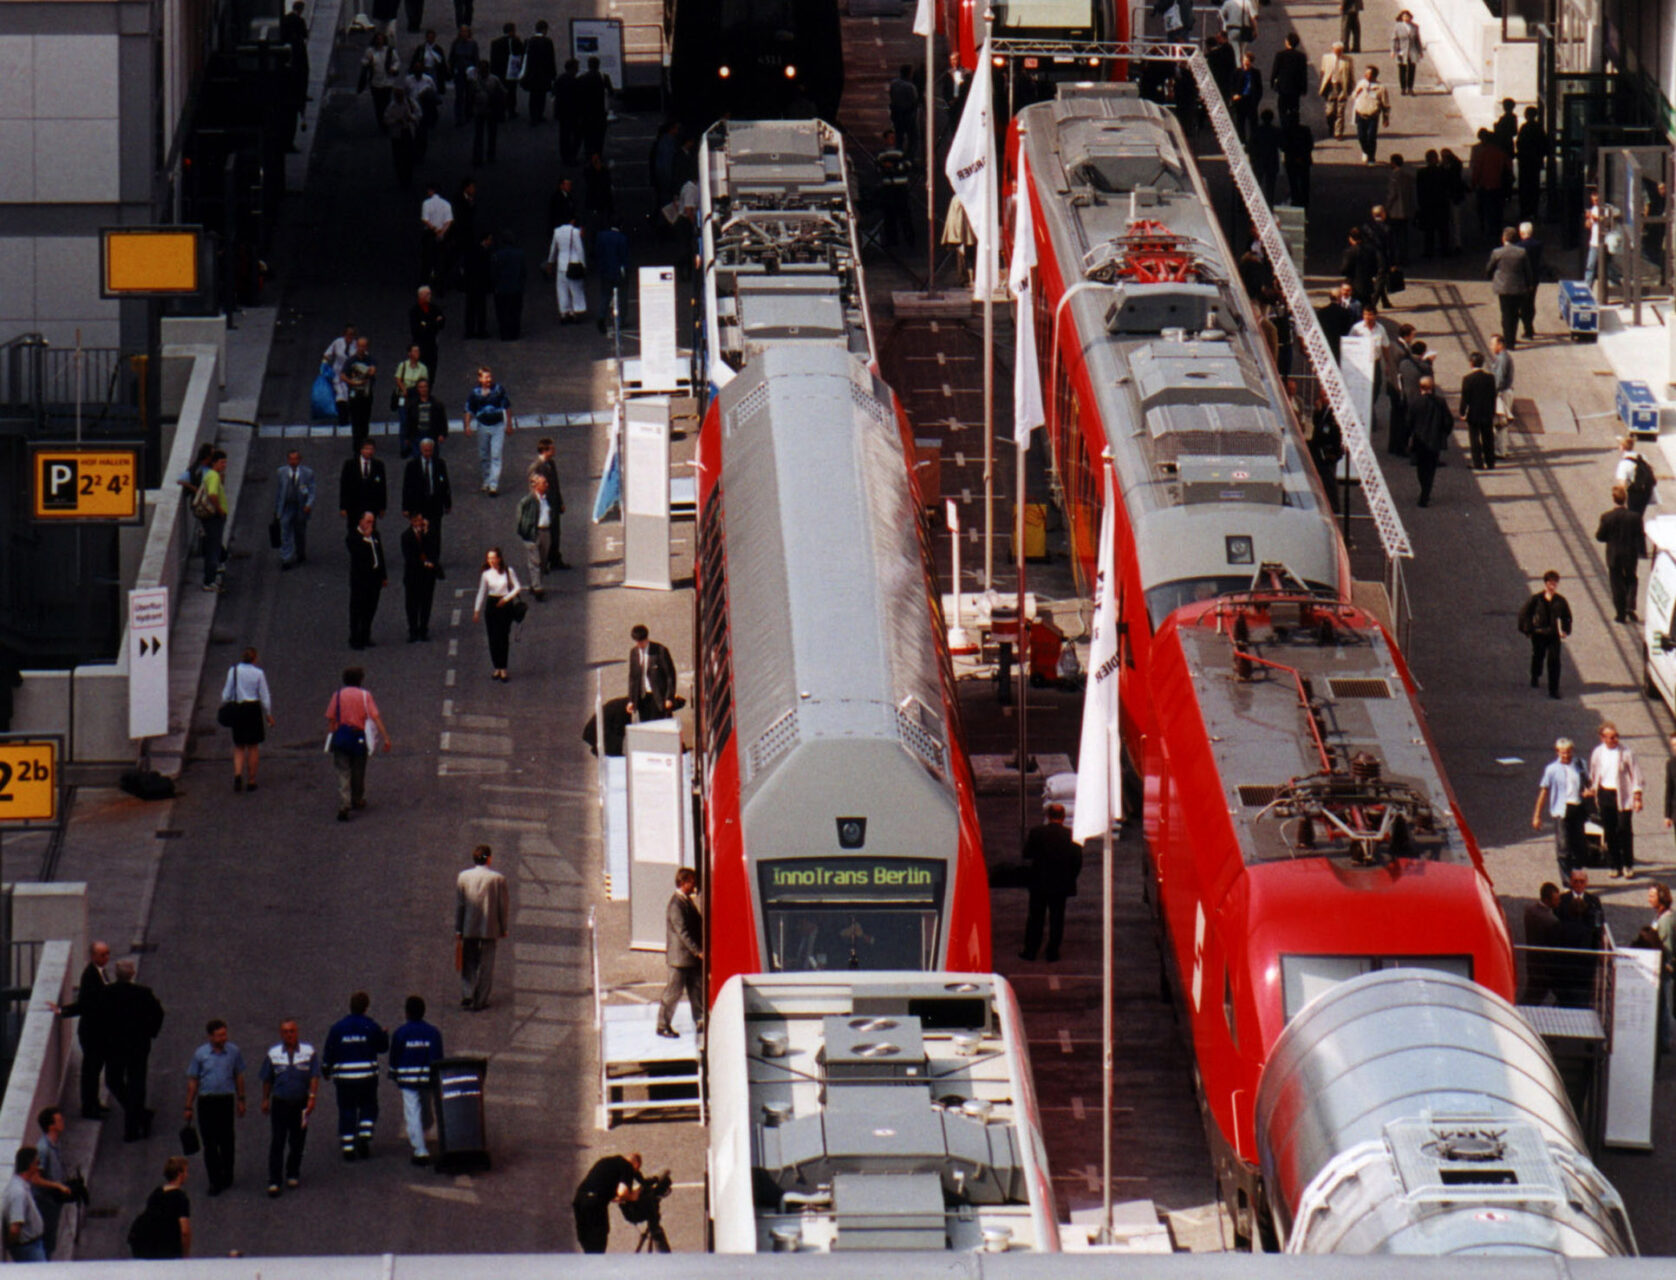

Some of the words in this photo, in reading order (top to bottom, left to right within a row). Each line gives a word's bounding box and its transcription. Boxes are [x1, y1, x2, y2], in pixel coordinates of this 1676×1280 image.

[51, 464, 72, 496] P
[773, 866, 869, 886] InnoTrans
[873, 866, 931, 885] Berlin
